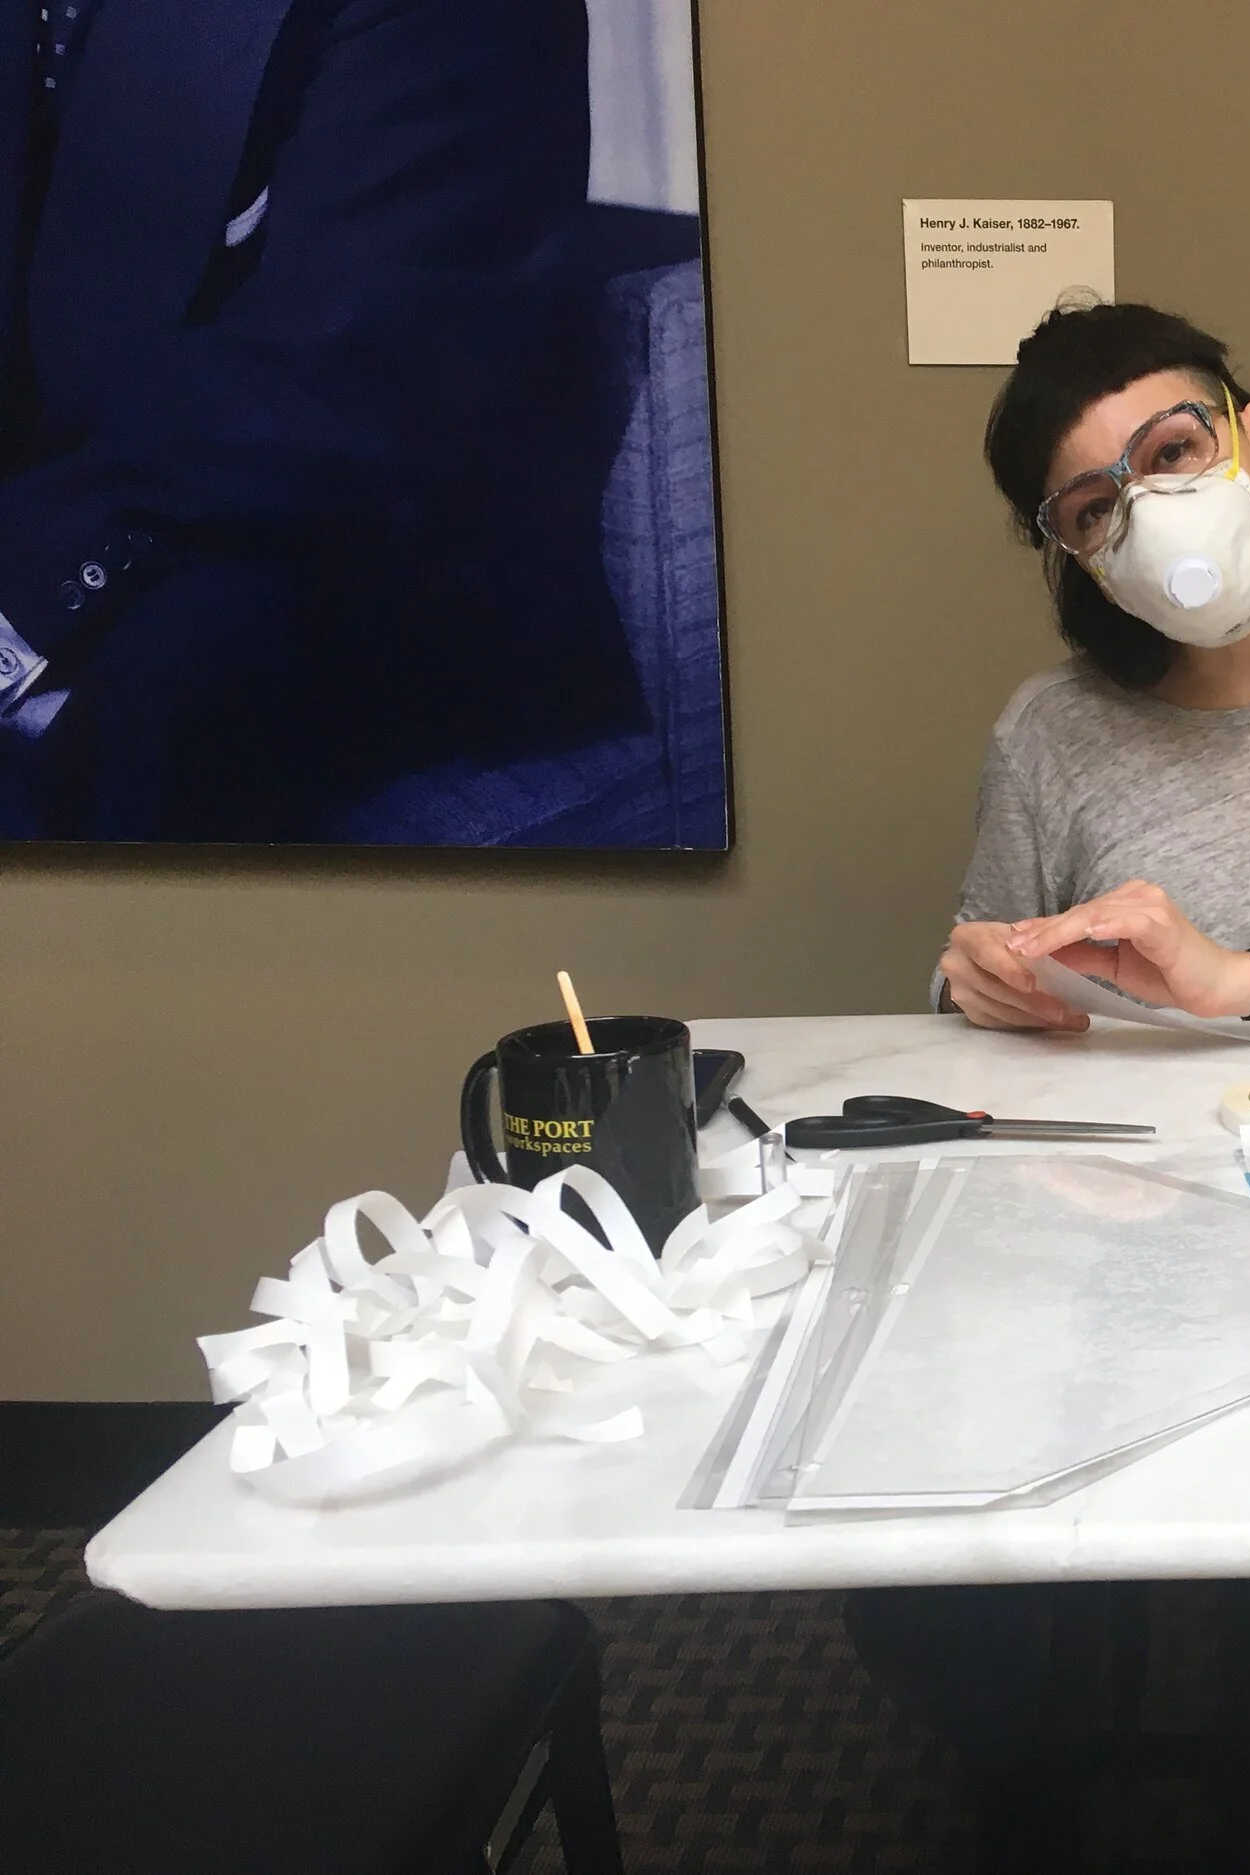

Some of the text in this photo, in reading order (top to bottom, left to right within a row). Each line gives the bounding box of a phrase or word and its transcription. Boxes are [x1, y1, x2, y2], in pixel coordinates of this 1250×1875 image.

[920, 218, 956, 230] Henry
[959, 218, 969, 229] J.
[973, 218, 1014, 230] Kaiser,
[921, 242, 1047, 253] Inventor, industrialist and
[921, 259, 994, 270] philanthropist.
[504, 1112, 594, 1138] THE PORT
